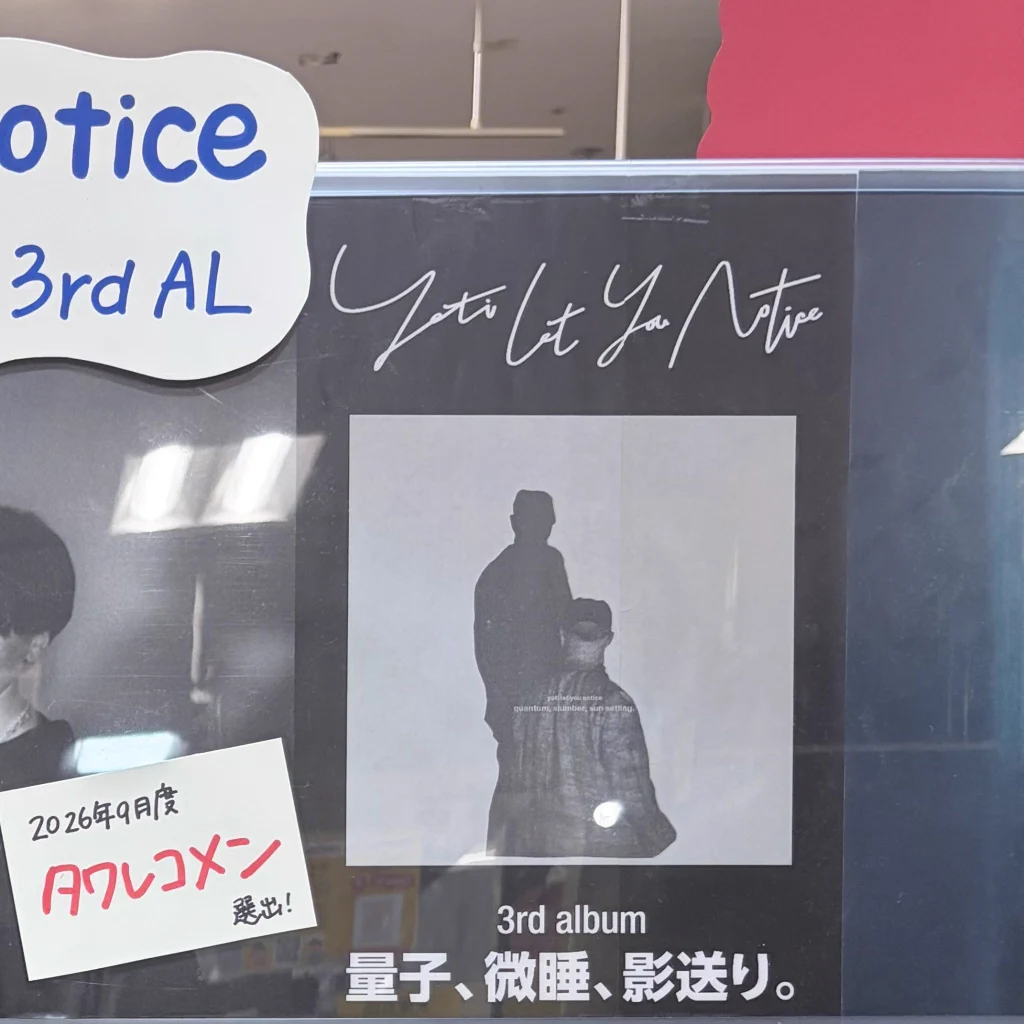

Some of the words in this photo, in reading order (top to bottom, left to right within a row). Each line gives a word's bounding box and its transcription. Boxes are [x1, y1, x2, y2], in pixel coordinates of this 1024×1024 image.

[154, 250, 252, 319] AL
[29, 782, 180, 841] 2026年9月度
[41, 834, 282, 916] タワレコメン
[497, 905, 545, 935] 3rd
[555, 905, 647, 935] album
[345, 949, 795, 1004] 量子、微睡、影送り。
